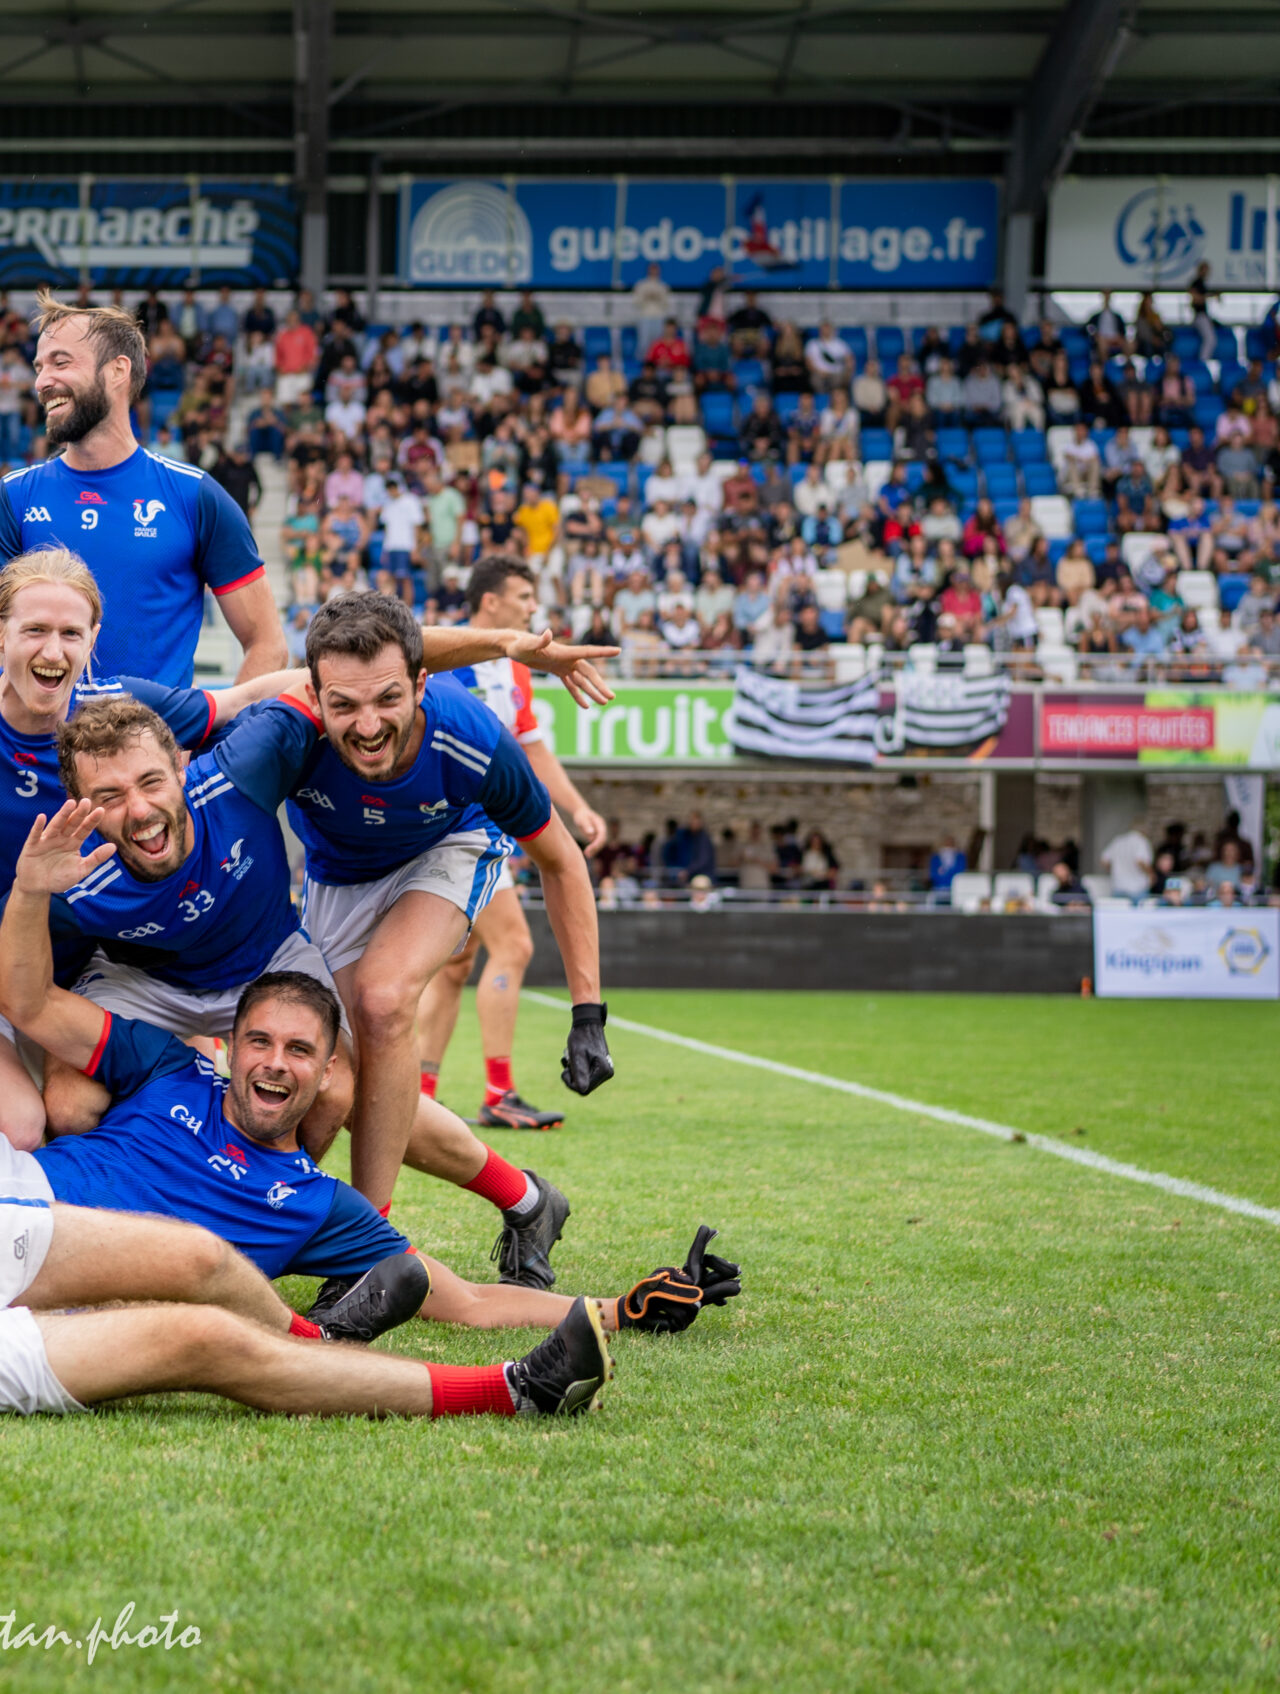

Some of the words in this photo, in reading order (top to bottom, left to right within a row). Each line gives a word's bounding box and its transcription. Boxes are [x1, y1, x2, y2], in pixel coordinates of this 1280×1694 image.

[549, 217, 985, 271] guedo-otillage.fr
[416, 250, 521, 275] GUEDO
[81, 509, 98, 530] 9
[15, 770, 39, 797] 3
[363, 807, 386, 825] 5
[178, 889, 215, 921] 33
[117, 921, 165, 939] GAA
